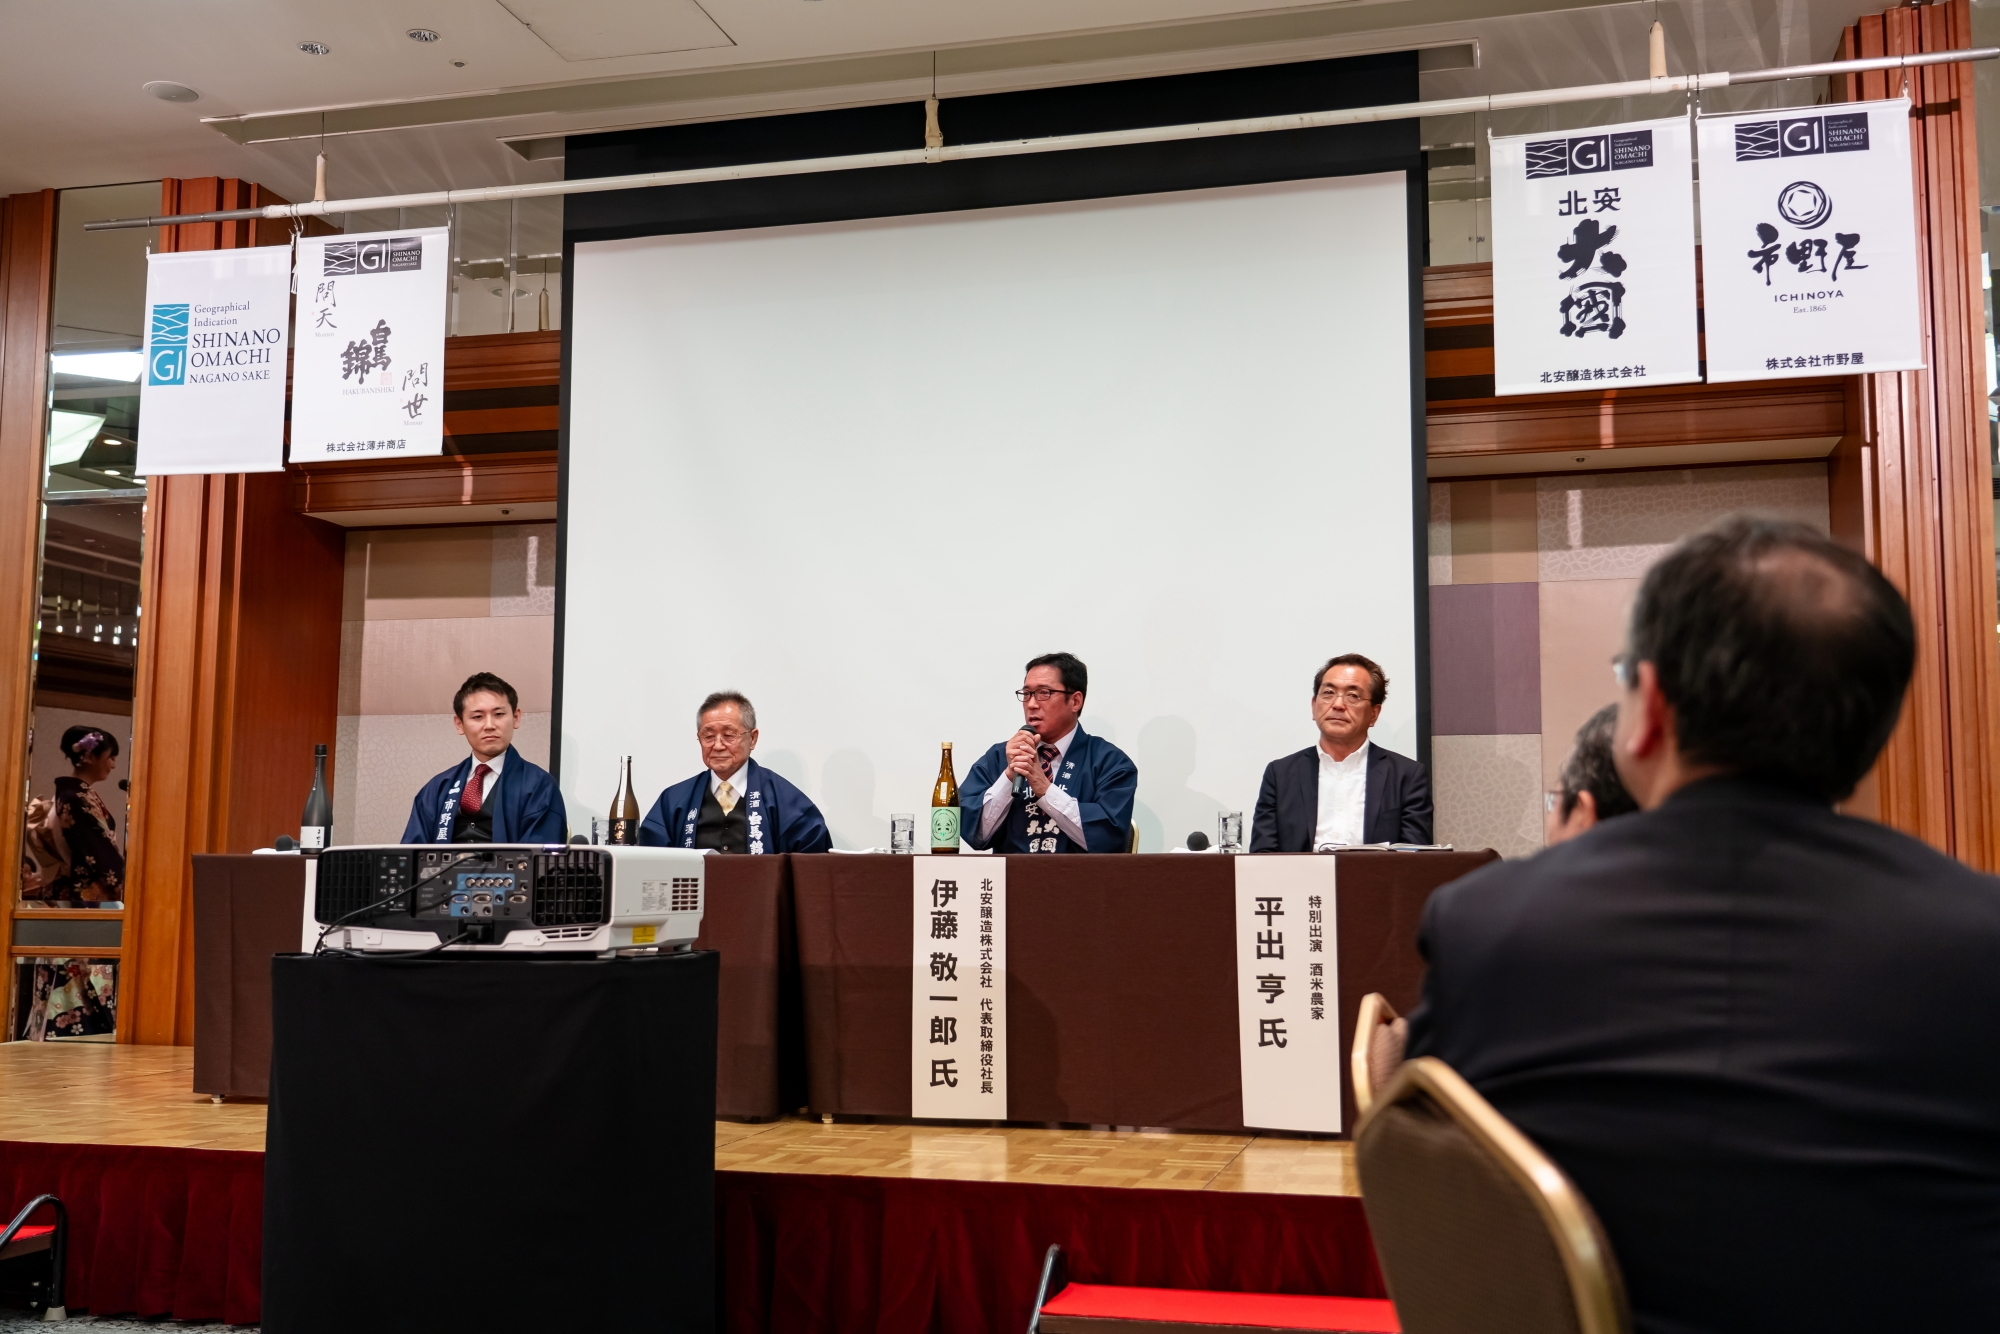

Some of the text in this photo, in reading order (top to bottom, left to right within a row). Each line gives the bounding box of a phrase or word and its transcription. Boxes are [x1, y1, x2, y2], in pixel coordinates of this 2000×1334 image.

[1783, 121, 1820, 151] GI
[1828, 127, 1866, 136] SHINANO
[1828, 133, 1863, 142] OMACHI
[1571, 138, 1607, 170] GI
[1614, 144, 1651, 154] SHINANO
[1614, 151, 1648, 160] OMACHI
[1558, 187, 1622, 216] 北安
[359, 243, 386, 270] GI
[392, 255, 418, 263] OMACHI
[1747, 222, 1869, 286] 市野屋
[1774, 289, 1844, 302] ICHINOYA
[194, 301, 250, 315] Geographical
[194, 317, 238, 327] Indication
[192, 328, 281, 349] SHINANO
[152, 349, 183, 381] GI
[191, 348, 271, 368] OMACHI
[1765, 352, 1865, 370] 株式会社市野屋
[189, 370, 271, 384] NAGANO SAKE
[342, 386, 395, 396] HAKUBANISHIKI
[326, 439, 406, 453] 株式会社薄井商店
[1308, 895, 1325, 1020] 特別出演 酒米農家
[1254, 896, 1288, 1049] 平出 亨 氏
[929, 879, 959, 1088] 伊藤 敬一郎 氏
[980, 878, 994, 1094] 北安醸造株式会社 代表取締役社長
